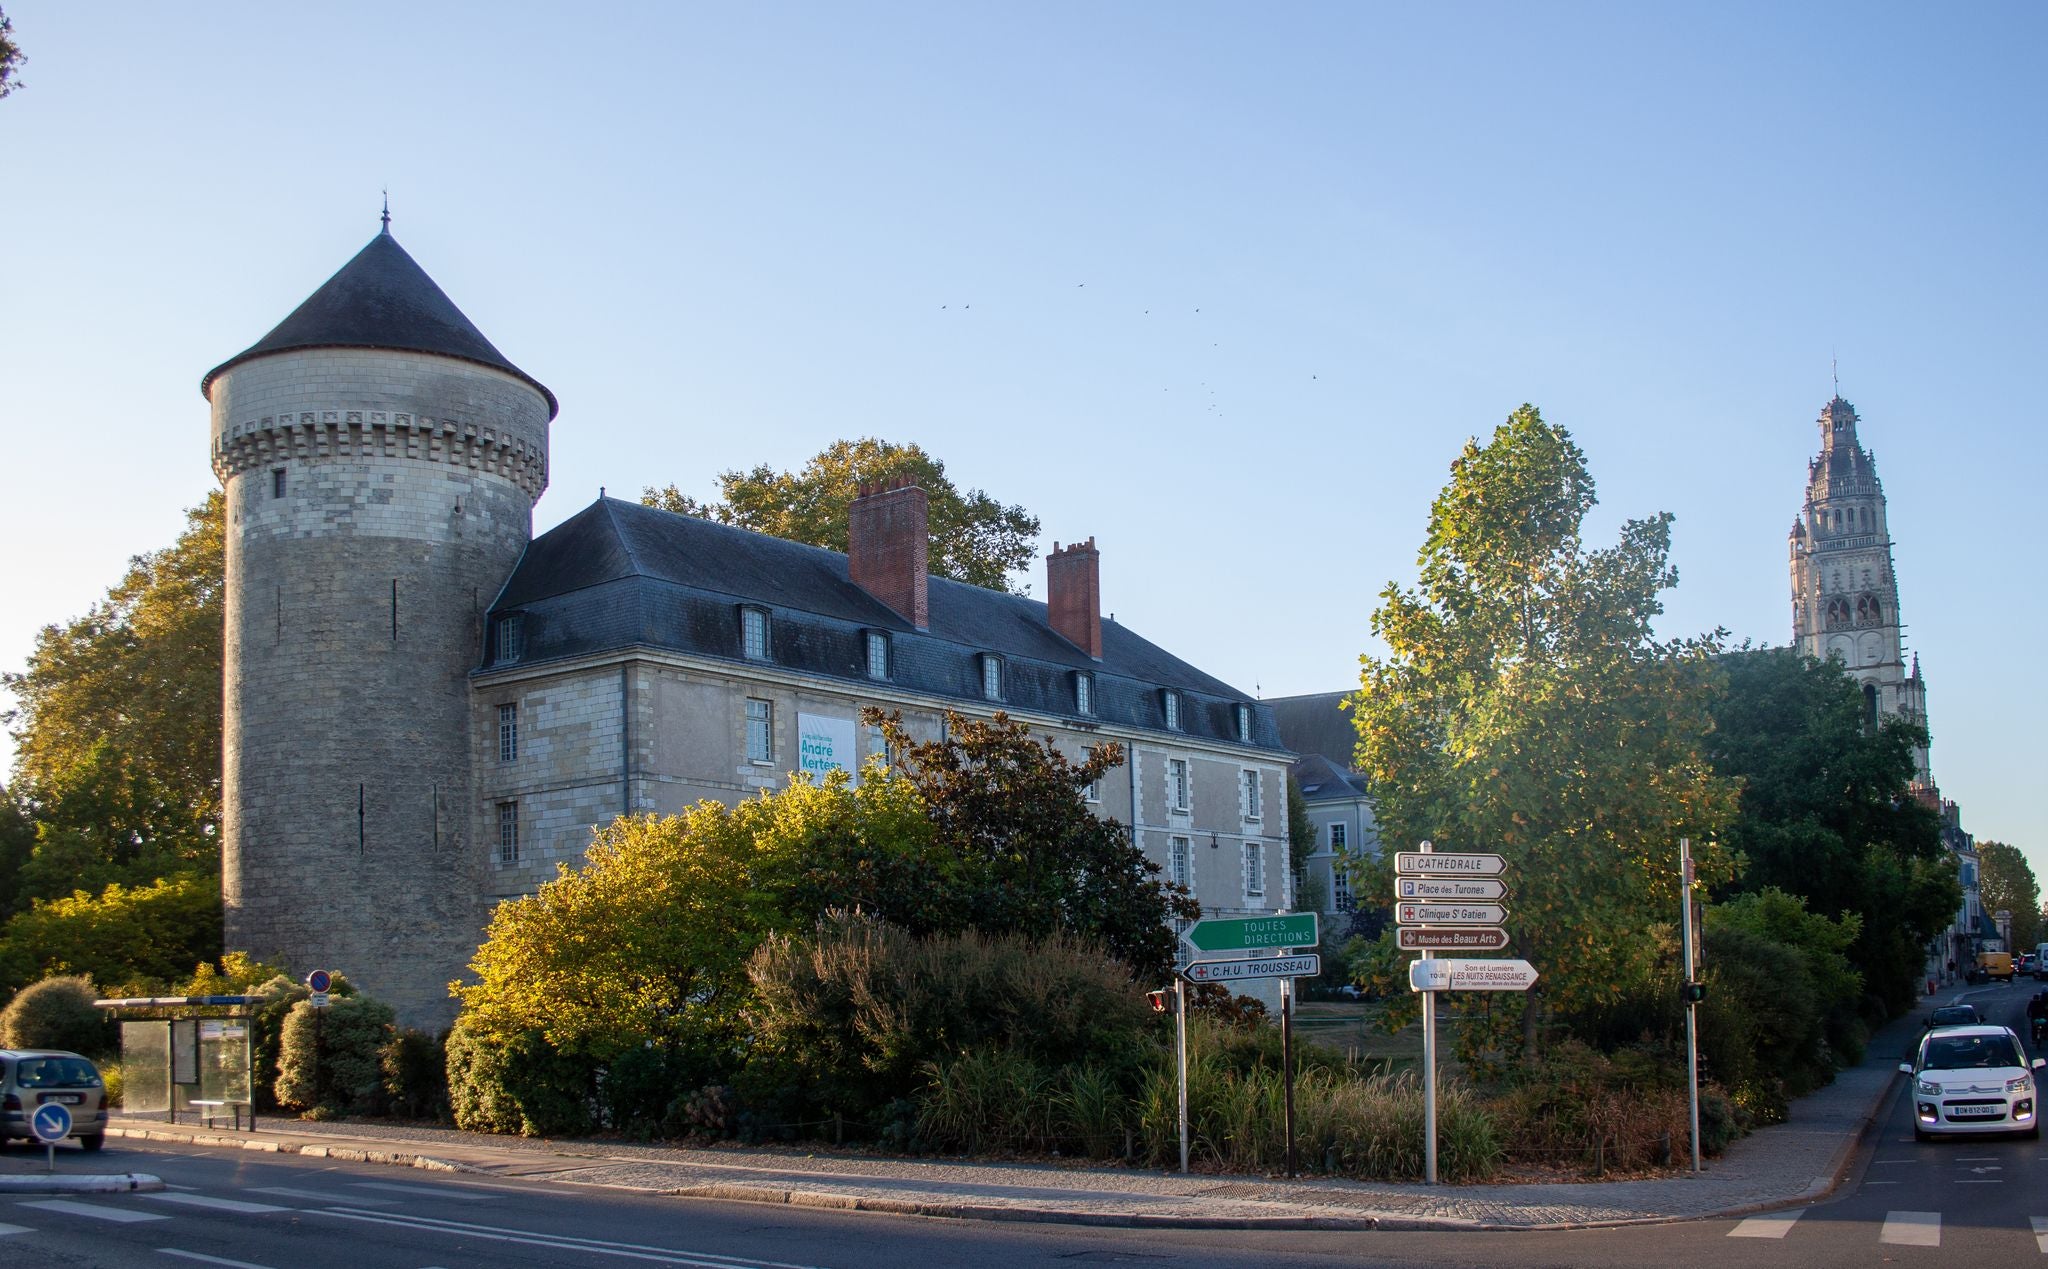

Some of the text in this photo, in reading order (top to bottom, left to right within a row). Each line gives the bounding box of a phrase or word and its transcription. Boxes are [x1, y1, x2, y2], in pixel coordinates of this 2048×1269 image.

[801, 739, 833, 757] André
[1418, 857, 1482, 870] CATHÉDRALE
[1417, 883, 1485, 895] Place des Turones
[1418, 908, 1451, 921] Clinique
[1461, 909, 1487, 919] Gatien
[1244, 920, 1287, 932] TOUTES
[1244, 931, 1311, 945] DIRECTIONS
[1418, 933, 1497, 944] Musée des Beaux Arts
[1212, 960, 1312, 977] C.H.U. TROUSSEAU
[1464, 963, 1515, 972] Son et Lumière
[1453, 972, 1527, 981] LES NUITS RENAISSANCE
